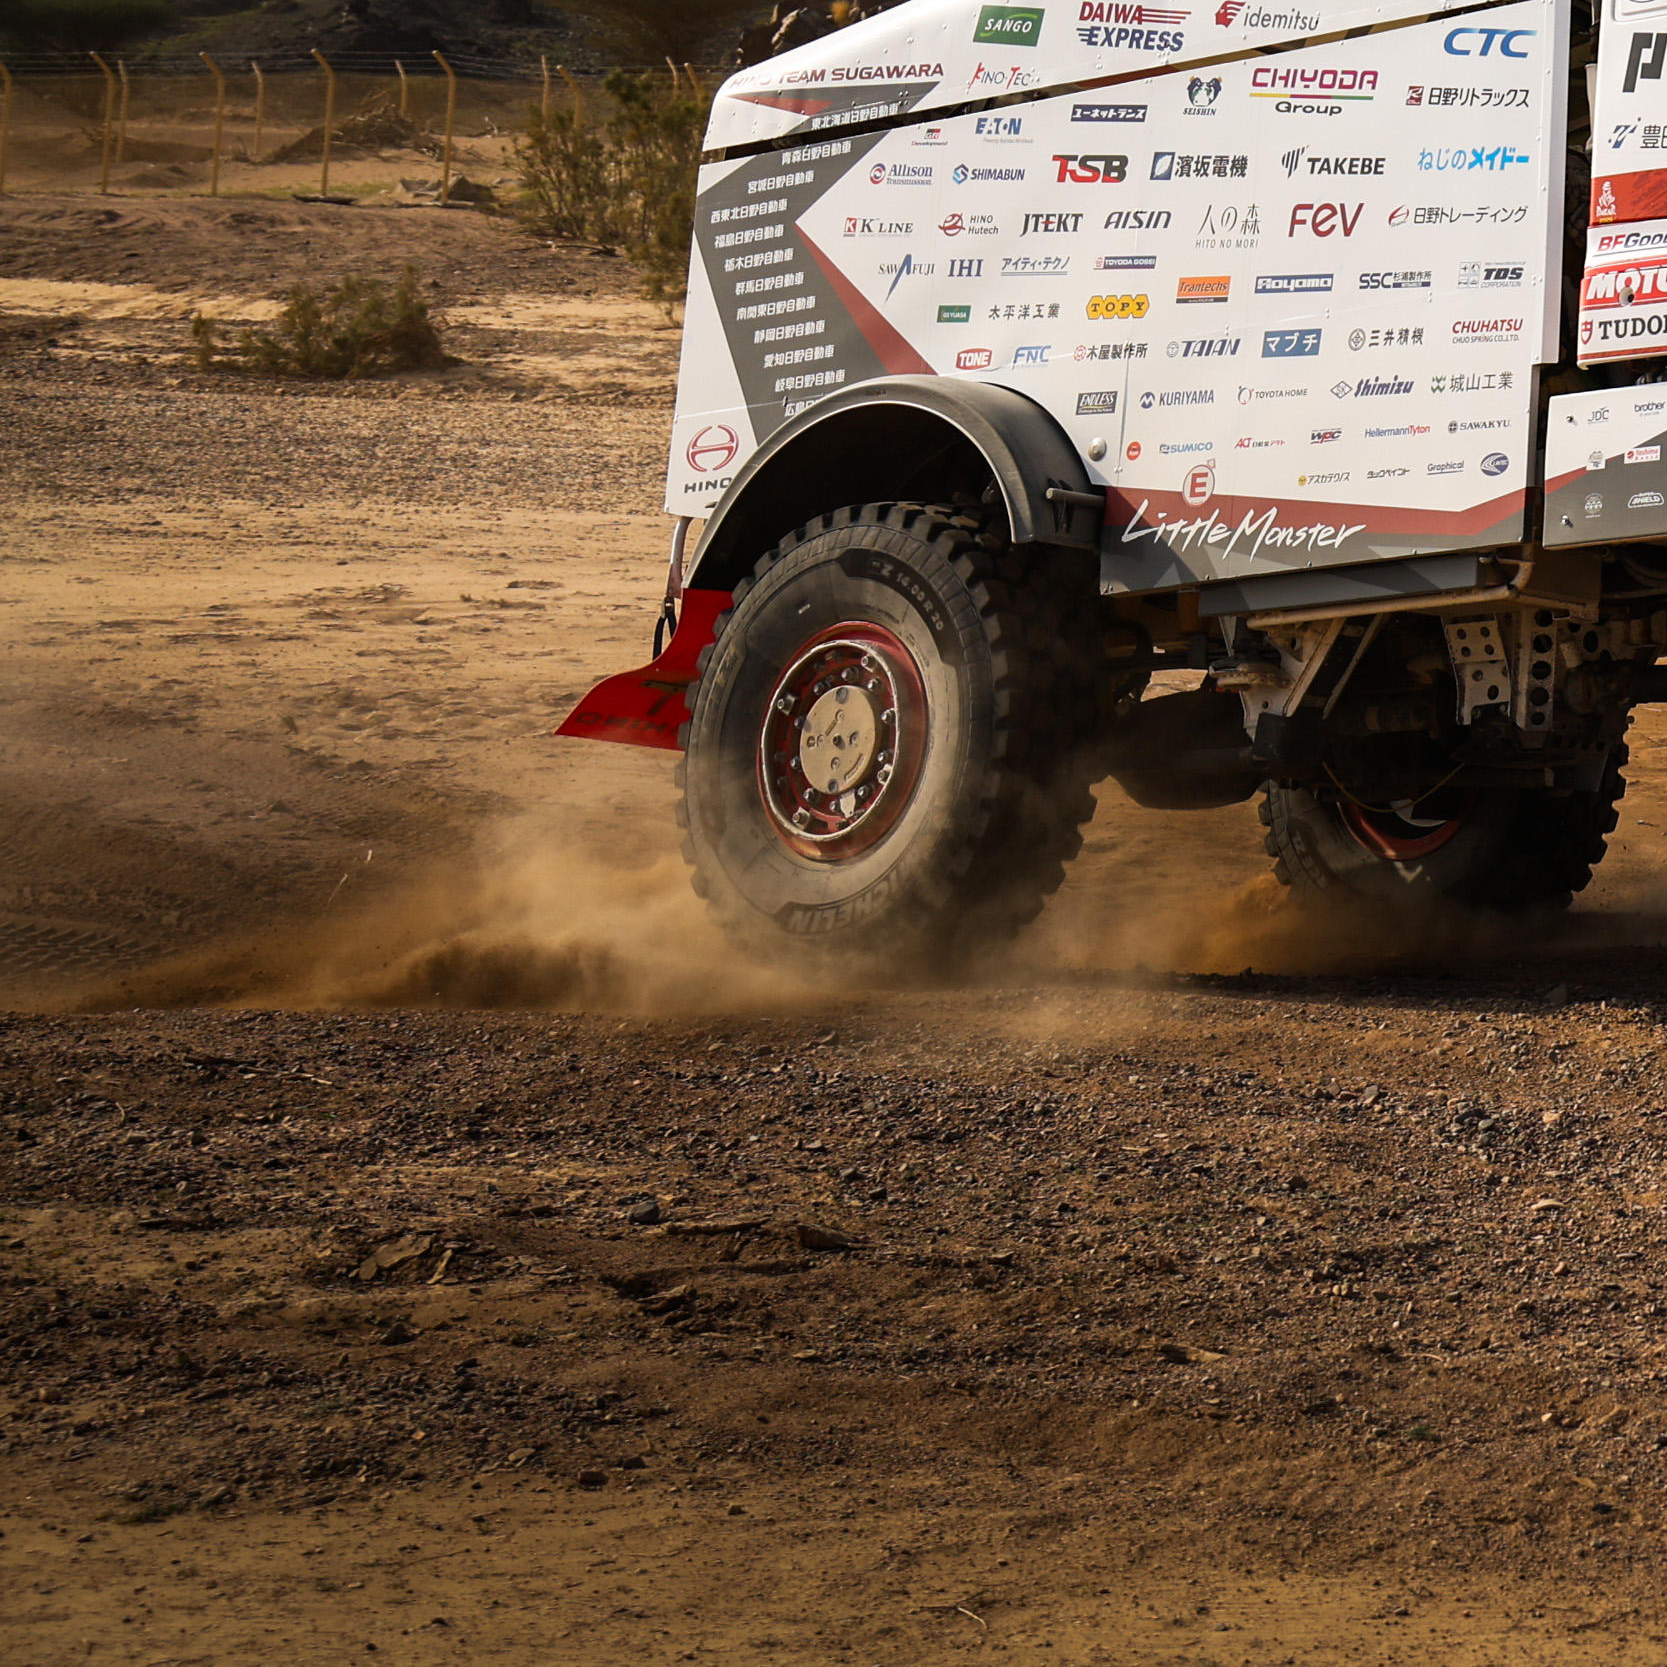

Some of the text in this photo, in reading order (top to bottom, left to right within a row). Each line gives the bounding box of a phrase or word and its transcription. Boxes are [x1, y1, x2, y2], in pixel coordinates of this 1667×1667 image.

[1079, 1, 1143, 25] DAIWA
[1243, 5, 1320, 31] idemitsu
[985, 18, 1033, 34] SANGO
[1082, 26, 1185, 52] EXPRESS
[1443, 27, 1538, 59] CTC
[777, 68, 826, 84] TEAM
[831, 63, 944, 82] SUGAWARA
[1251, 68, 1379, 90] CHIYODA
[1428, 87, 1530, 108] 日野リトラックス
[810, 102, 900, 131] 東北海道日野自動車
[1071, 107, 1148, 121] ユーネットランス
[1183, 107, 1217, 117] SEISHIN
[1275, 101, 1343, 116] Group
[781, 140, 852, 166] 青森日野自動車
[1417, 146, 1530, 171] ねじのメイドー
[888, 163, 933, 178] Allison
[970, 168, 1025, 182] SHIMABUN
[1052, 154, 1129, 183] TSB
[1174, 155, 1249, 178] 濱坂電機
[1307, 157, 1386, 175] TAKEBE
[747, 170, 815, 194] 宮城日野自動車
[711, 198, 788, 224] 西東北日野自動車
[970, 215, 993, 224] HINO
[1104, 209, 1172, 230] AISIN
[1198, 203, 1261, 236] 人の森
[1413, 205, 1528, 224] 日野トレーディング
[879, 222, 914, 233] LINE
[968, 225, 999, 235] Hutech
[1019, 213, 1083, 237] JTEKT
[714, 224, 785, 248] 福島日野自動車
[1195, 239, 1259, 249] HITO NO MORI
[948, 259, 984, 277] IHI
[1105, 257, 1132, 266] TOYODA
[735, 272, 804, 295] 群馬日野自動車
[1359, 272, 1393, 289] SSC
[1483, 267, 1524, 281] TDS
[988, 302, 1062, 321] 太平洋工業
[1091, 301, 1145, 313] TOPY
[1452, 318, 1524, 334] CHUHATSU
[1265, 332, 1319, 353] マブチ
[1368, 327, 1425, 347] 三井精機
[1452, 336, 1470, 344] CHUO
[1470, 335, 1493, 344] SPRING
[1013, 346, 1051, 365] FNC
[1087, 342, 1149, 359] 木屋製作所
[1182, 338, 1241, 357] TAIAN
[959, 350, 990, 367] TONE
[1354, 375, 1415, 398] Shimizu
[1449, 371, 1514, 392] 城山工業
[1079, 392, 1115, 407] ENDLESS
[1159, 389, 1214, 407] KURIYAMA
[1255, 388, 1308, 398] TOYOTA HOME
[1634, 401, 1666, 413] brother
[1365, 425, 1431, 438] HellermannTyton
[1460, 420, 1510, 430] SAWAKYU
[1170, 441, 1213, 454] SUMICO
[1427, 459, 1465, 472] Graphical
[684, 477, 732, 494] HINO
[1189, 472, 1208, 499] E
[1121, 499, 1366, 563] Little Monster
[930, 610, 945, 631] 20
